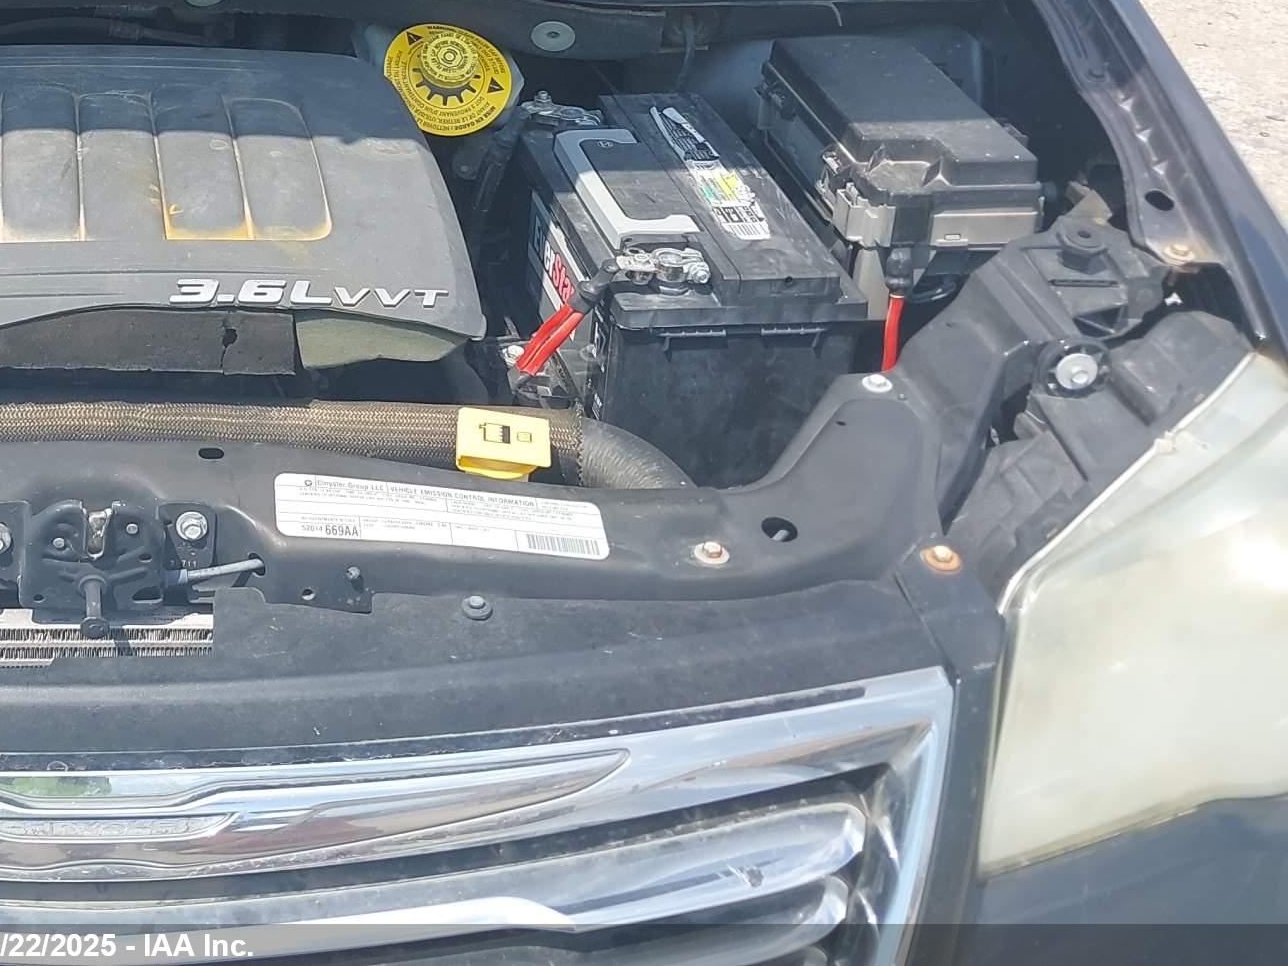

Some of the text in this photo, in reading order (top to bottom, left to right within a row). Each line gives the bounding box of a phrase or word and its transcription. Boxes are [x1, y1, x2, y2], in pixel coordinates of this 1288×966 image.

[169, 278, 449, 308] 3.6L VVT
[348, 482, 369, 492] Group
[390, 486, 418, 494] VEHICLE
[420, 489, 453, 498] EMISSION
[454, 492, 486, 502] CONTROL
[488, 496, 535, 507] INFORMATION
[325, 524, 359, 537] 669AA
